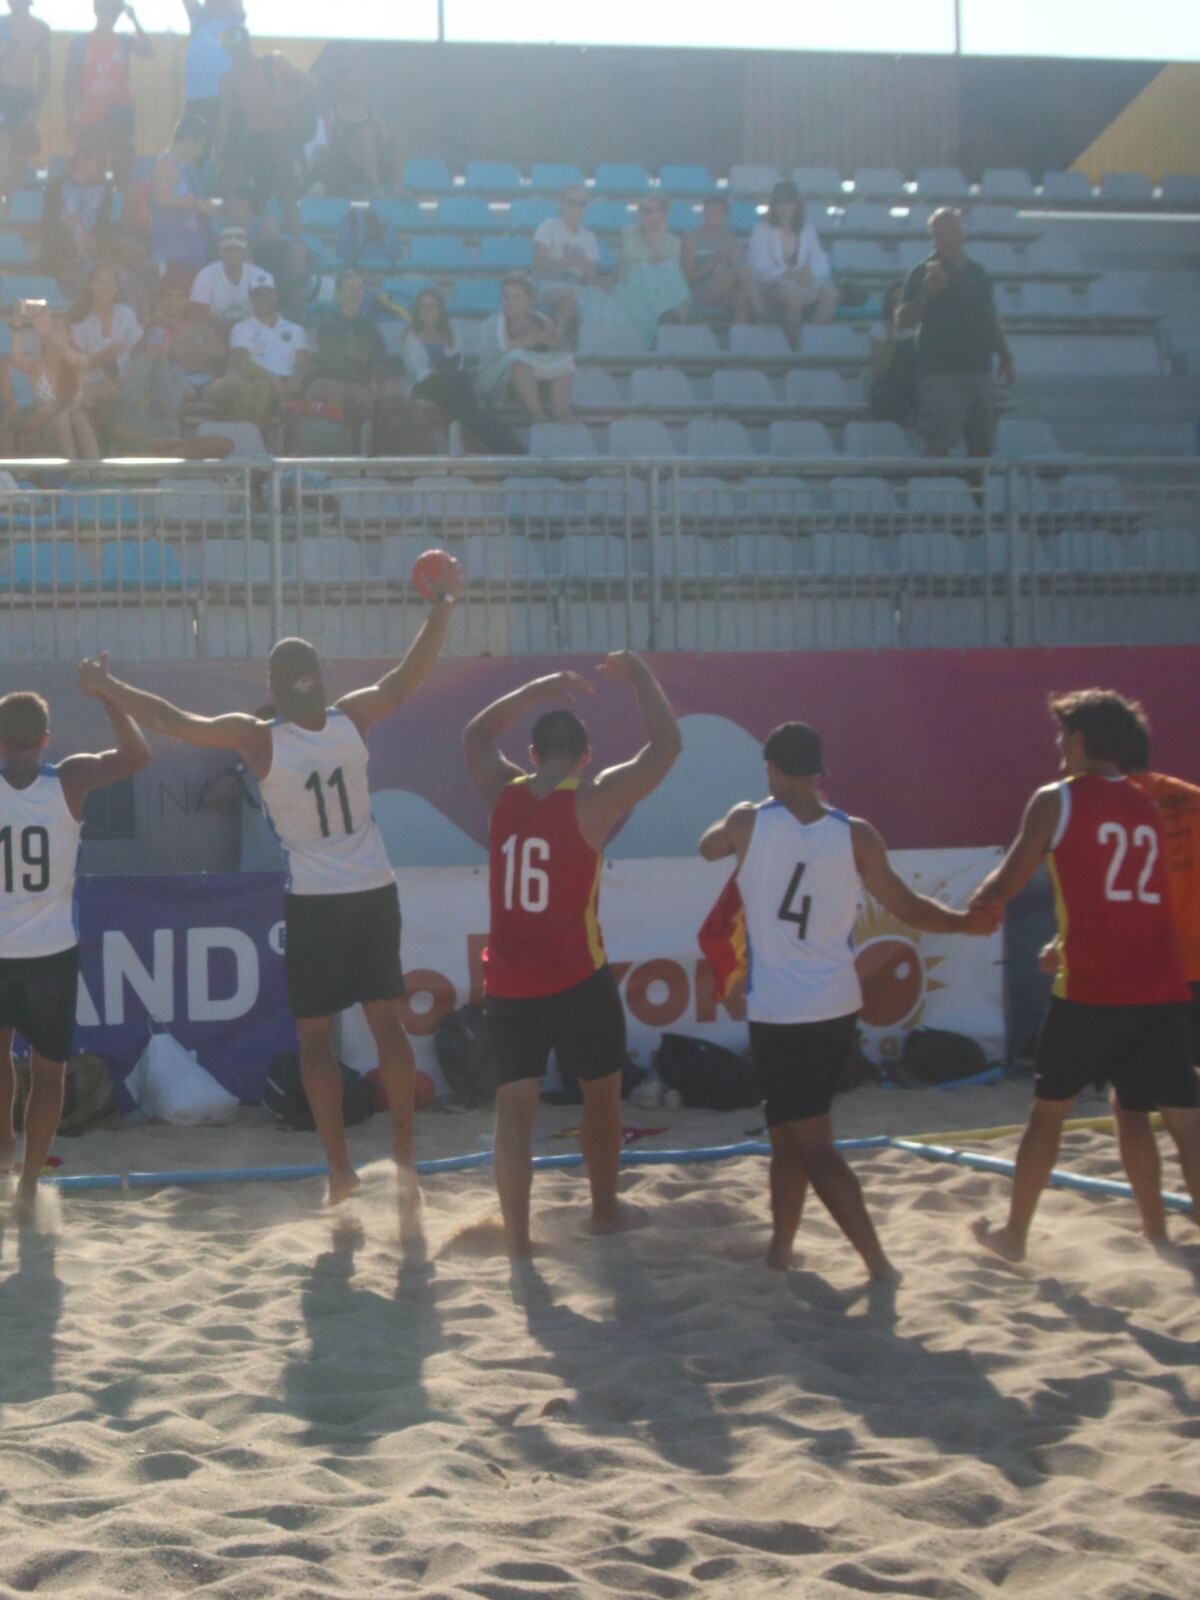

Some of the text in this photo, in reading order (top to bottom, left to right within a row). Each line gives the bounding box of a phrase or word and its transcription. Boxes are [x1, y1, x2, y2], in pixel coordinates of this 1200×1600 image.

[304, 766, 354, 838] 11
[501, 834, 550, 913] 16
[777, 862, 812, 940] 4
[1097, 822, 1161, 905] 22
